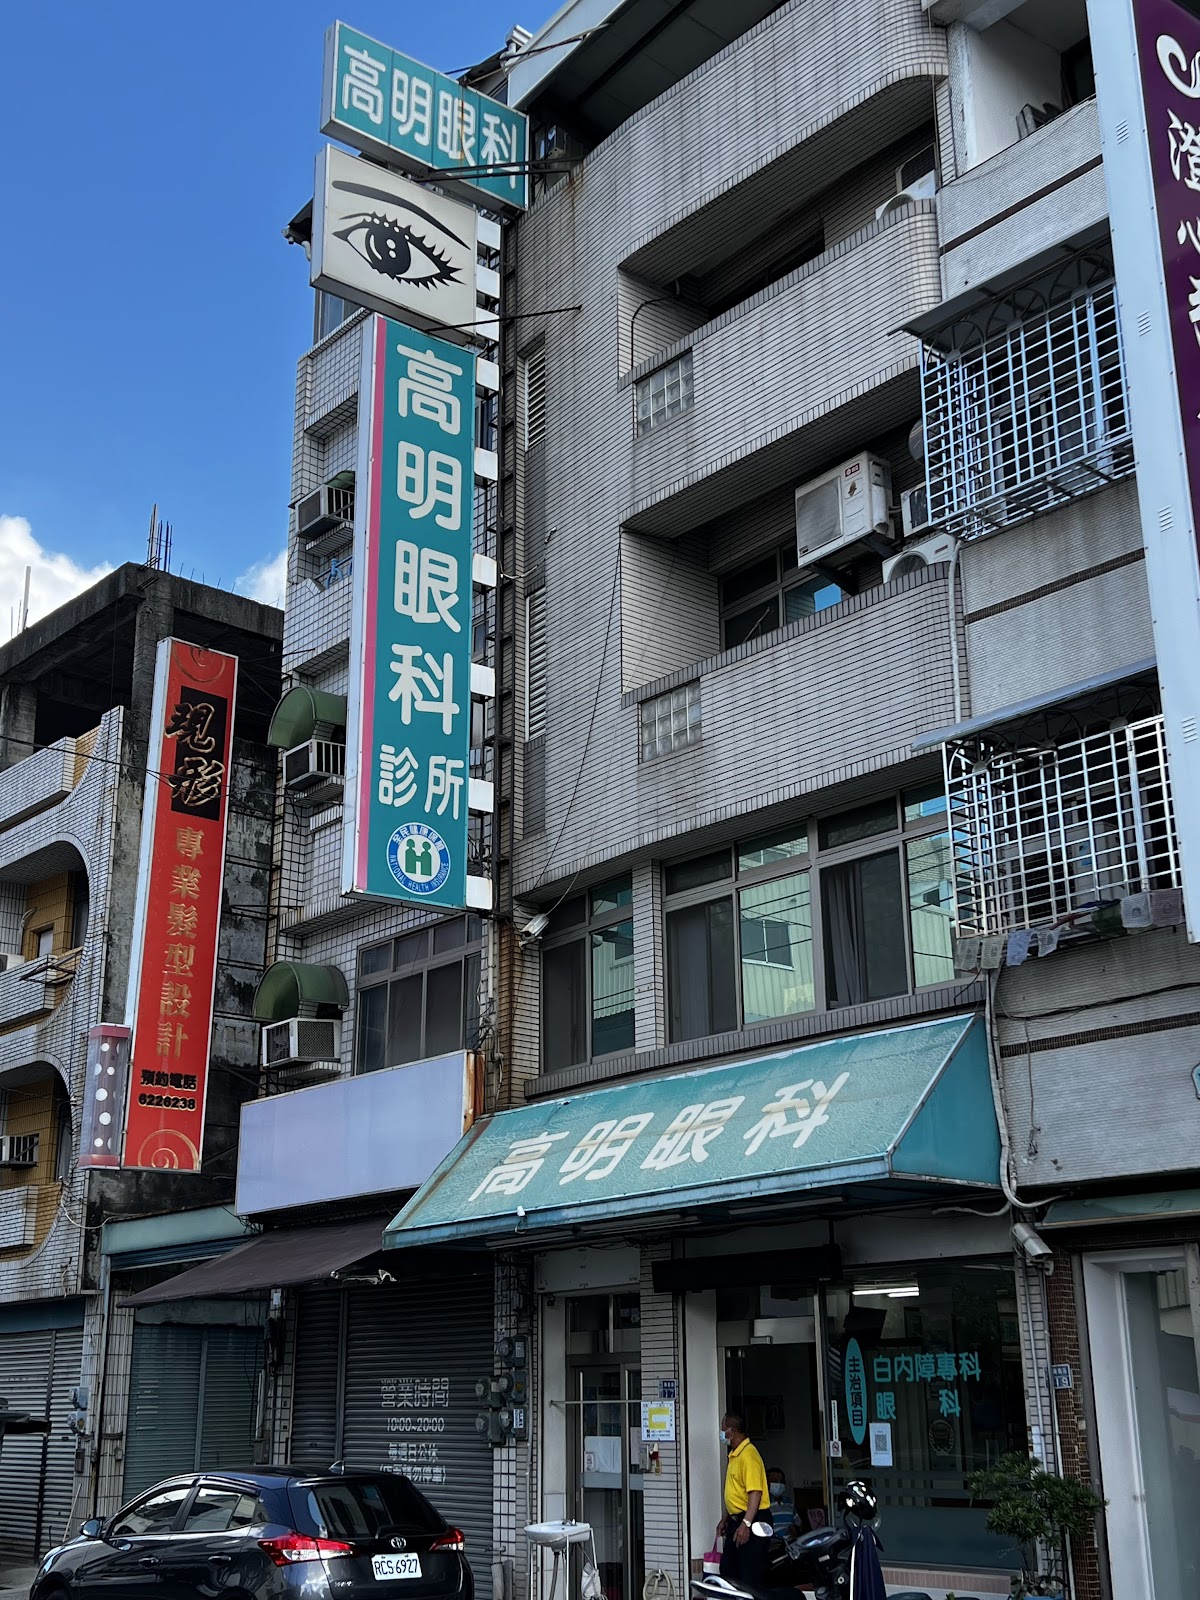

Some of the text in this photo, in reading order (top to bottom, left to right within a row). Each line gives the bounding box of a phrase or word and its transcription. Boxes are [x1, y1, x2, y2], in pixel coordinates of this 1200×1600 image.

[341, 44, 520, 190] 高明眼科
[388, 343, 464, 736] 高明眼科
[378, 743, 465, 821] 診所
[389, 854, 406, 885] NATIONAL
[408, 881, 429, 892] HEALTH
[156, 826, 204, 1059] 專業髮型設計
[138, 1093, 196, 1111] 6226238
[140, 1069, 197, 1091] 預約電話
[467, 1071, 850, 1203] 高明眼科
[380, 1377, 450, 1408] 營業時間
[848, 1356, 863, 1427] 主治項目
[873, 1351, 981, 1383] 白內障專科
[875, 1389, 961, 1420] 眼 科
